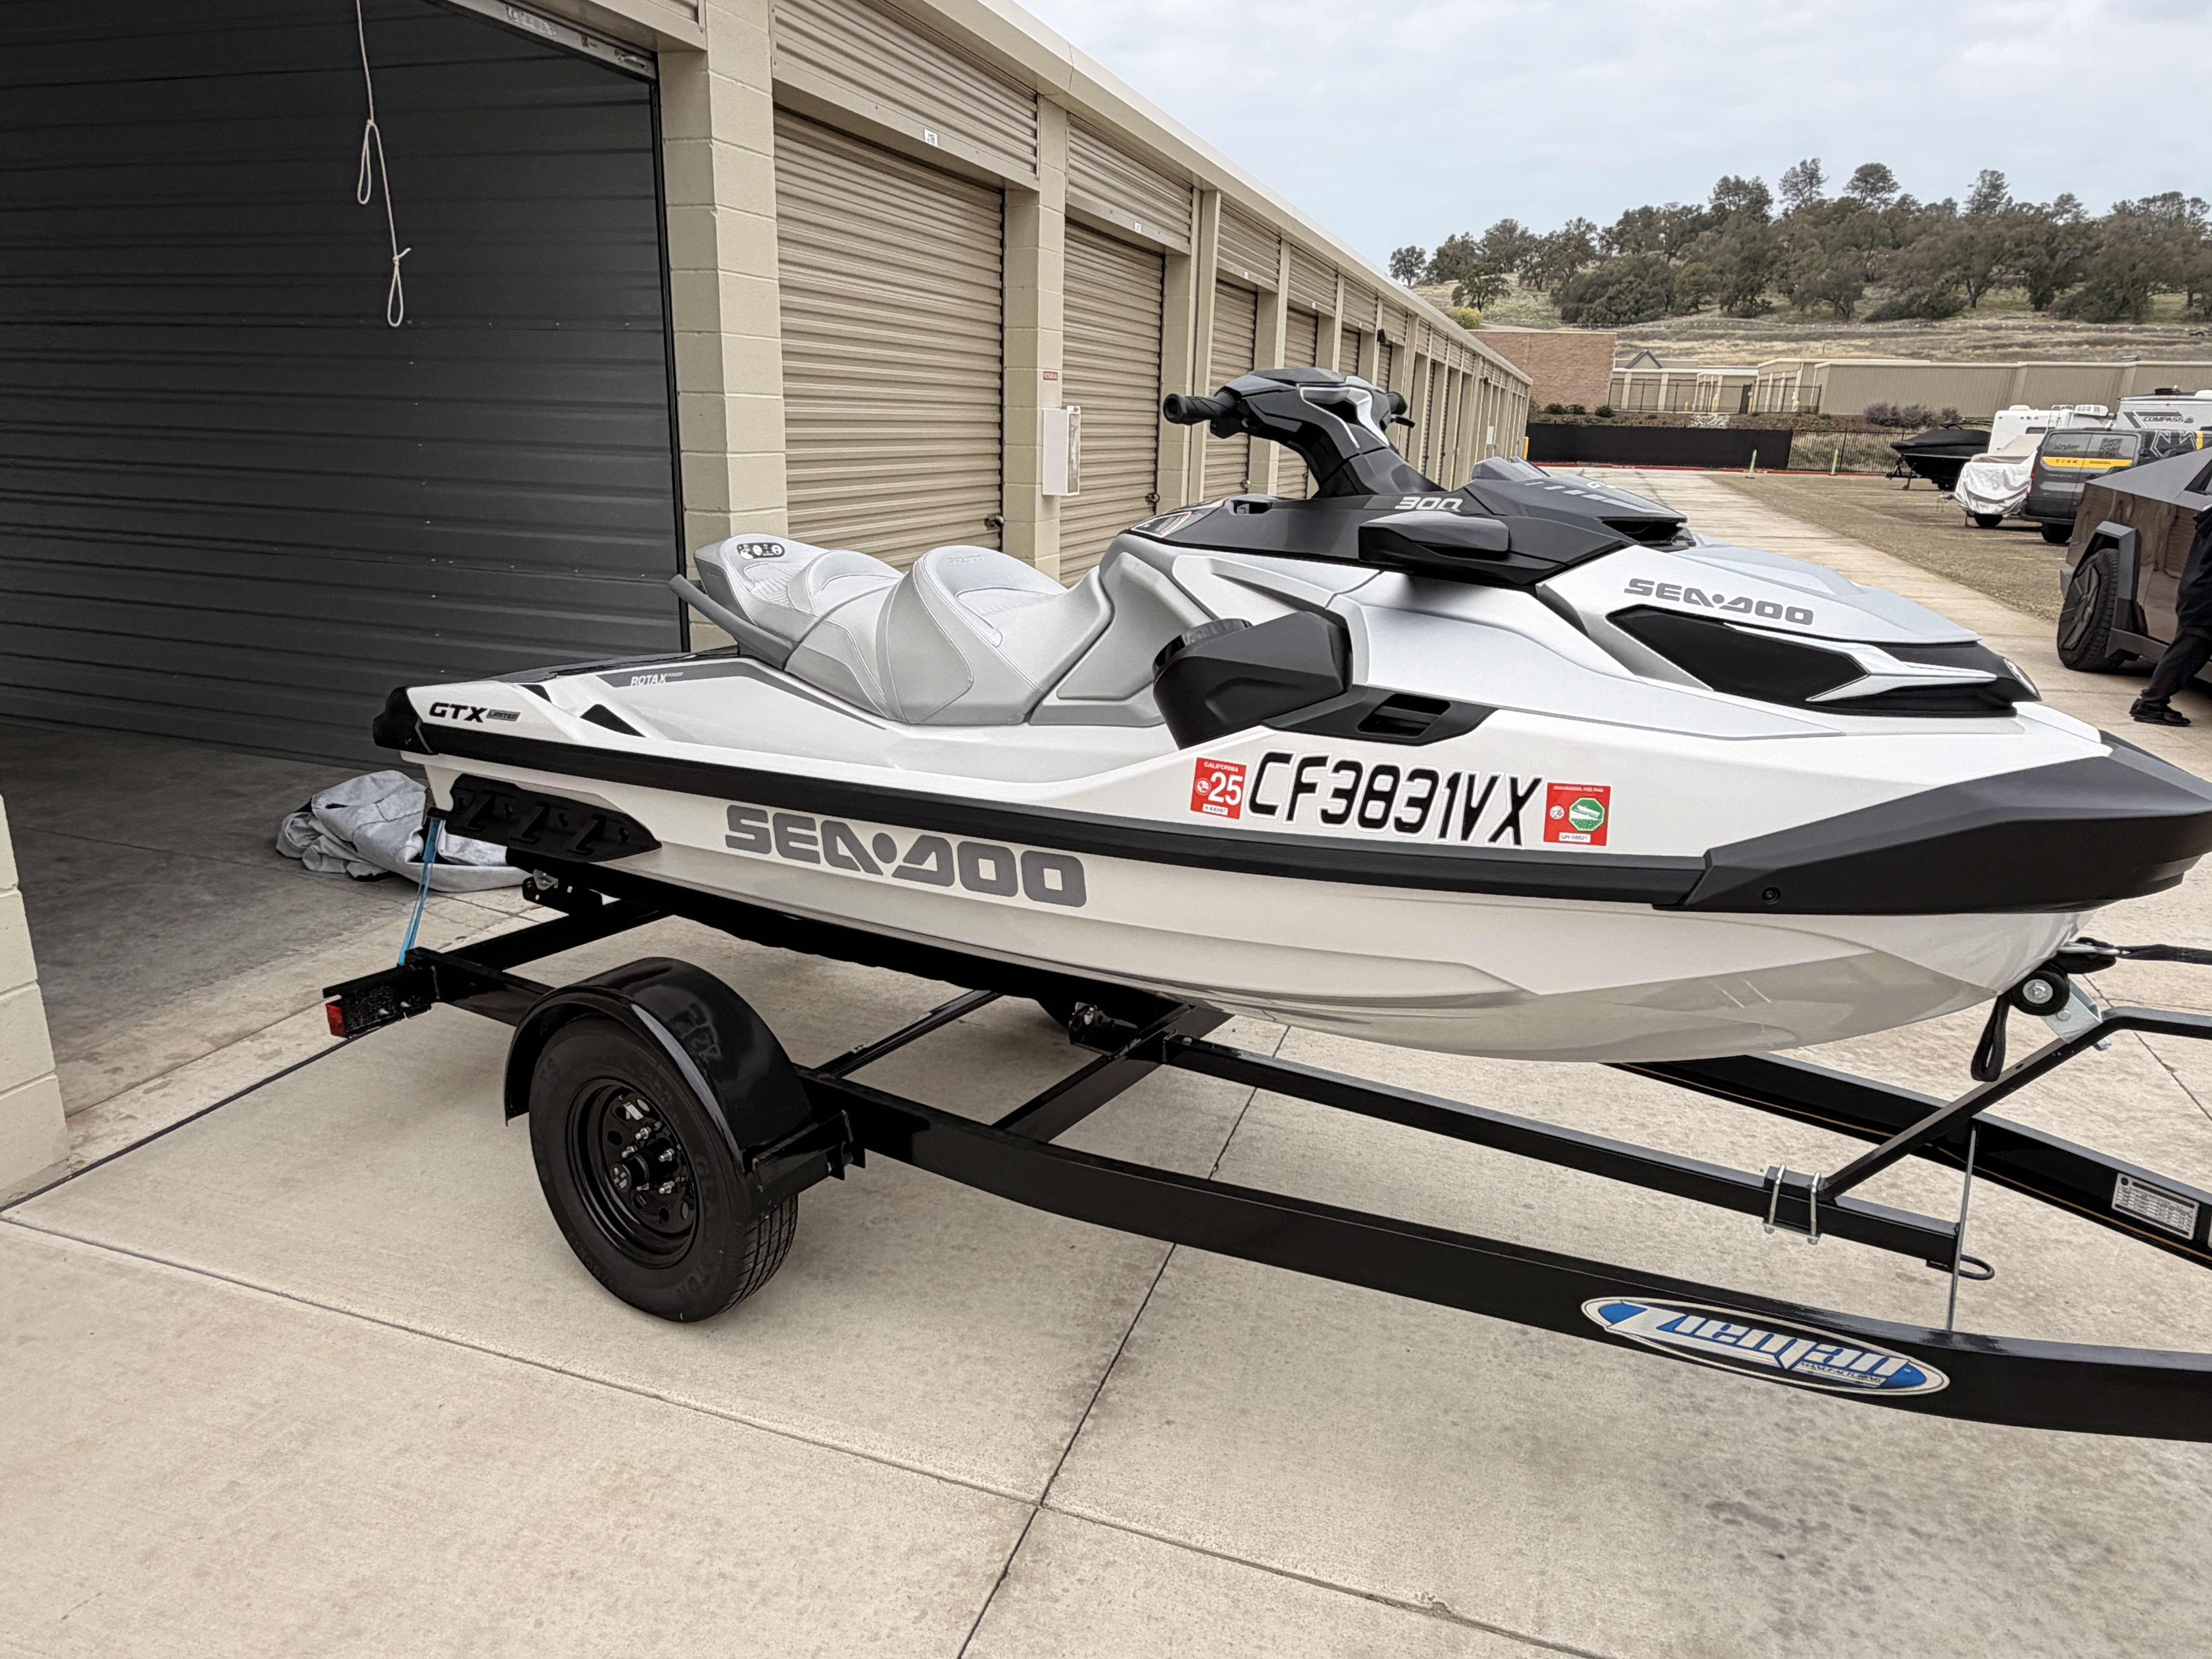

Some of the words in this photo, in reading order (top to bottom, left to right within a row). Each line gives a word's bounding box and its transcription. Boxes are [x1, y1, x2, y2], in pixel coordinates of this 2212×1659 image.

[630, 673, 666, 686] ROTAX
[429, 702, 488, 723] GTX
[1204, 761, 1239, 772] CALIFORNIA
[1207, 771, 1243, 805] 25
